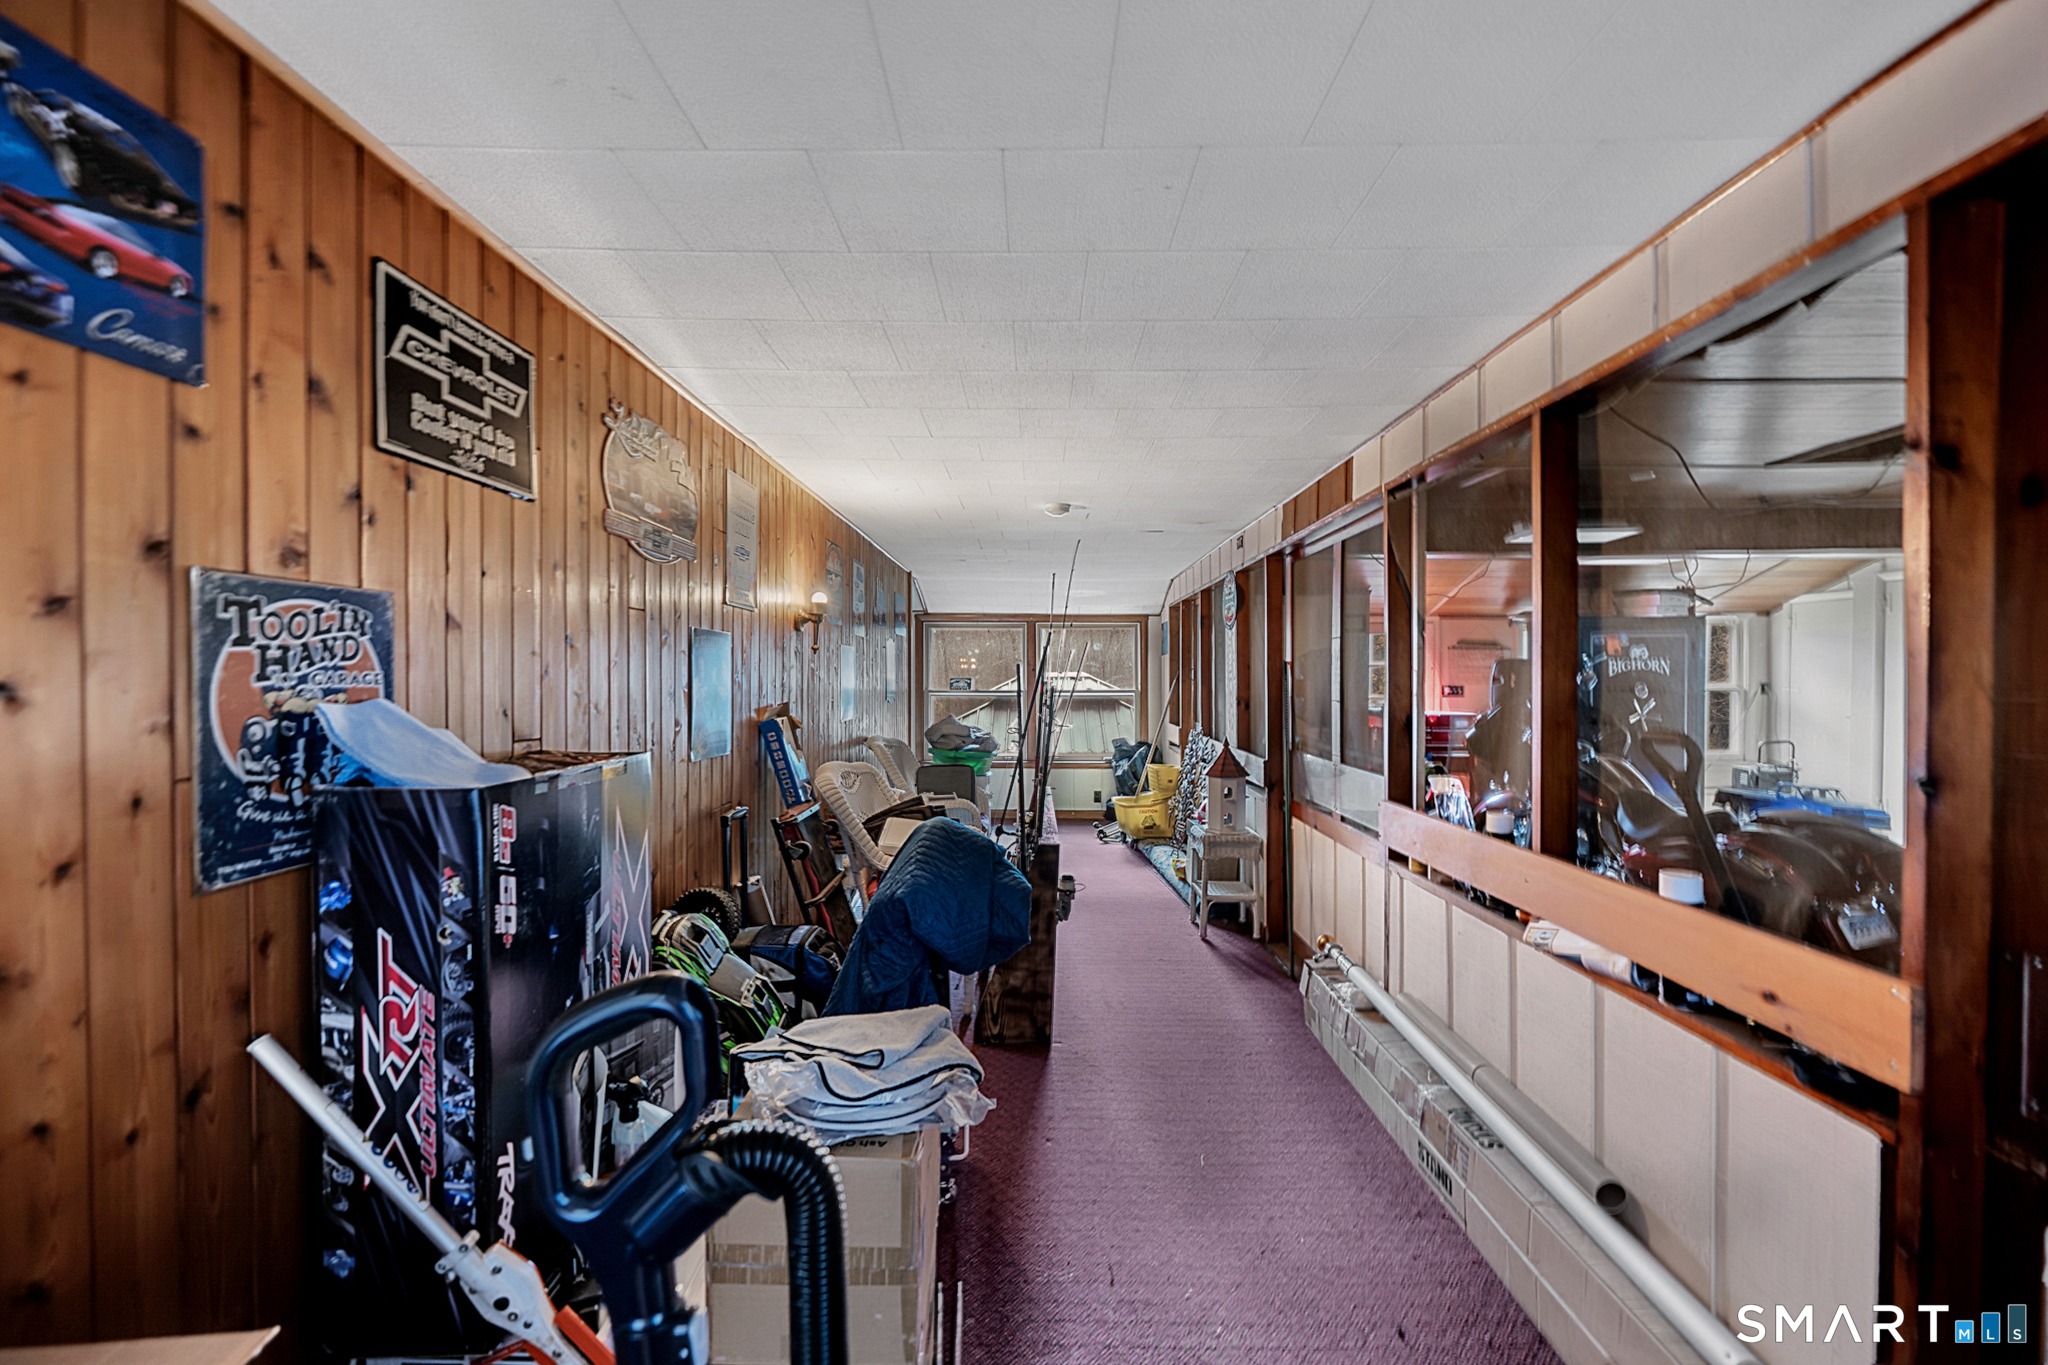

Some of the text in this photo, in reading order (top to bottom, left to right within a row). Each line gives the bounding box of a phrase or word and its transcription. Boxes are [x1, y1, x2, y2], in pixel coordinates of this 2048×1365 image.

[85, 308, 188, 363] Camaro
[406, 339, 519, 406] CHEVROLET
[411, 391, 446, 422] But
[495, 428, 515, 450] be
[251, 634, 363, 687] HAND
[307, 670, 385, 688] GARAGE
[1607, 656, 1671, 677] BIGHORN
[419, 983, 438, 1179] ULTIMATE
